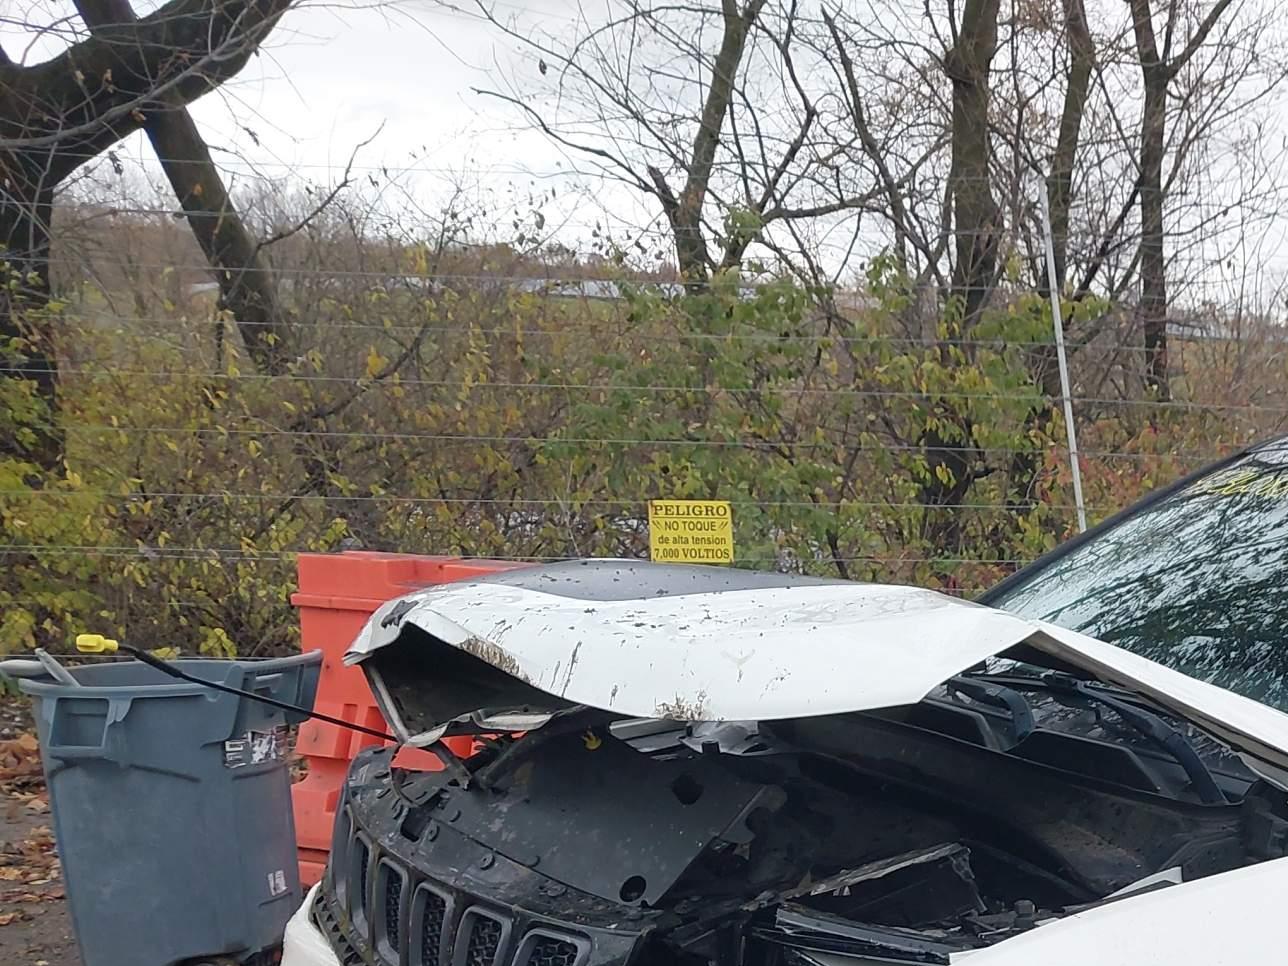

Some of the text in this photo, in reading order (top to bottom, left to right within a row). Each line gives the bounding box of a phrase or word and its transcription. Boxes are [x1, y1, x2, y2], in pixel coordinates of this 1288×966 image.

[654, 504, 727, 516] PELIGRO
[664, 520, 717, 532] NO TOQUE
[658, 534, 727, 545] de alta tension
[682, 548, 730, 559] VOLTIOS
